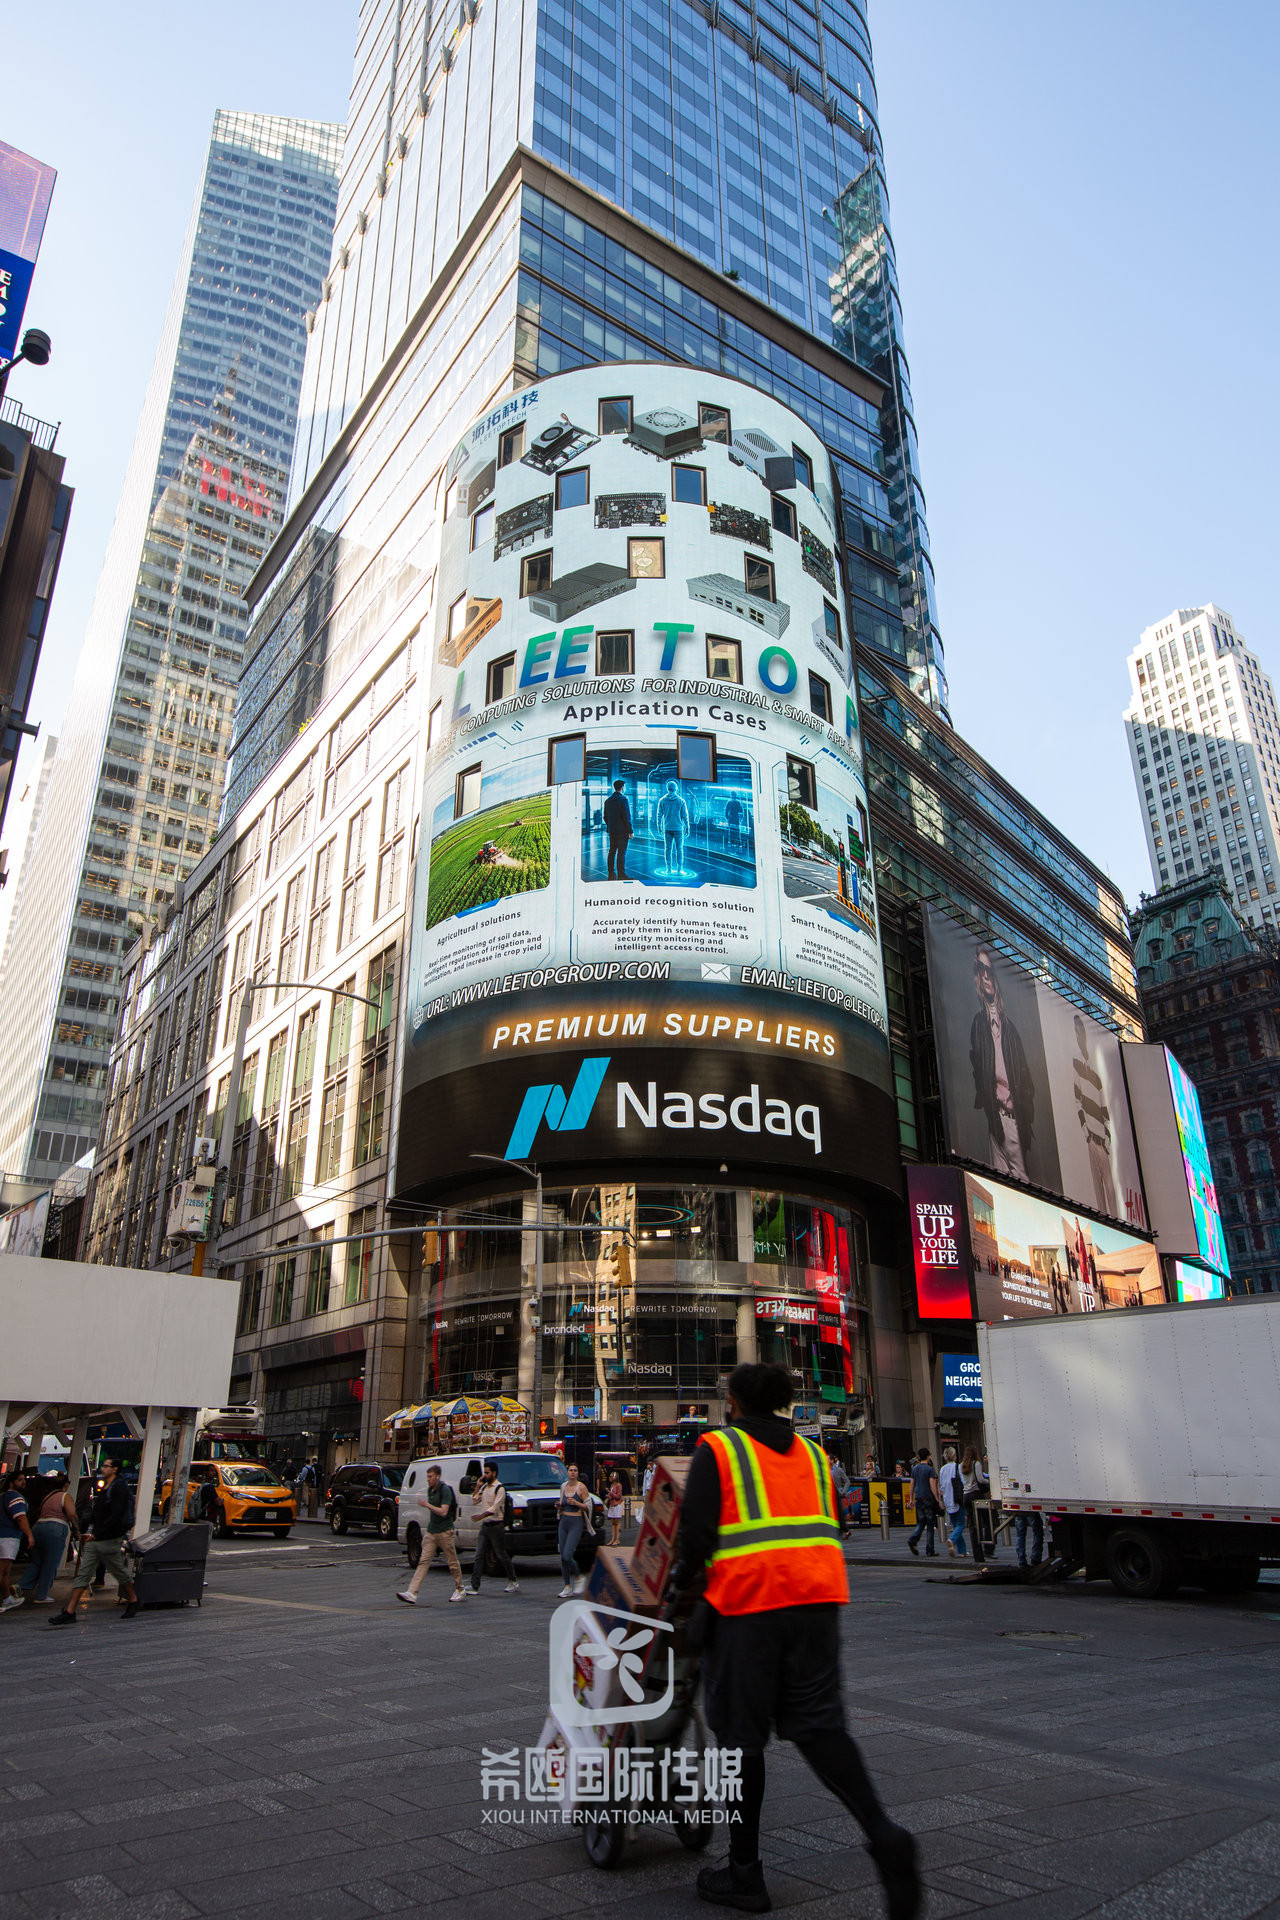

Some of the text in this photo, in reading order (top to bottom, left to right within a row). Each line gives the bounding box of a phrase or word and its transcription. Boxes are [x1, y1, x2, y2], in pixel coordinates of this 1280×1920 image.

[480, 411, 526, 445] LEETOPTECH
[460, 692, 537, 736] COMPUTING
[542, 678, 635, 703] SOLUTIONS
[641, 678, 676, 693] FOR
[679, 679, 770, 711] INDUSTRIAL
[772, 699, 783, 715] &
[784, 704, 824, 734] SMART
[563, 700, 767, 731] Application Cases
[584, 897, 755, 913] Humanoid recognition solution
[437, 911, 521, 946] Agricultural solutions
[591, 927, 608, 935] and
[611, 926, 635, 935] apply
[675, 928, 716, 936] scenarios
[593, 917, 747, 931] Accurately identify human features
[791, 914, 815, 929] Smart
[817, 920, 862, 951] transportation
[452, 940, 487, 957] monitoring
[497, 933, 511, 941] soil
[614, 943, 661, 952] intelligent
[695, 945, 729, 954] control.
[617, 935, 652, 944] security
[655, 935, 705, 945] monitoring
[804, 938, 833, 953] Integrate
[833, 948, 846, 959] road
[448, 951, 480, 968] regulation
[490, 938, 524, 952] irrigation
[526, 935, 542, 943] and
[453, 963, 465, 972] and
[466, 955, 493, 968] increase
[503, 948, 521, 958] crop
[522, 943, 542, 955] yield
[801, 947, 826, 960] parking
[827, 955, 858, 975] management
[796, 953, 823, 966] enhance
[824, 961, 841, 973] traffic
[740, 965, 795, 992] EMAIL:
[426, 961, 670, 1019] URL: WWW.LEETOPGROUP.COM
[492, 1013, 836, 1057] PREMIUM SUPPLIERS
[617, 1081, 822, 1155] Nasdaq
[916, 1203, 953, 1216] SPAIN
[917, 1215, 955, 1237] UP
[919, 1237, 957, 1249] YOUR
[920, 1249, 959, 1265] LIFE
[1001, 1291, 1013, 1301] YOUR
[1013, 1294, 1021, 1302] LIFE
[1077, 1280, 1095, 1294] SPAIN
[583, 1304, 615, 1315] Nasdaq
[630, 1305, 718, 1314] REWRITE TOMORROW
[1079, 1292, 1096, 1312] UP
[454, 1316, 475, 1326] REWRITE
[477, 1311, 513, 1322] TOMORROW
[627, 1362, 672, 1376] Nasdaq
